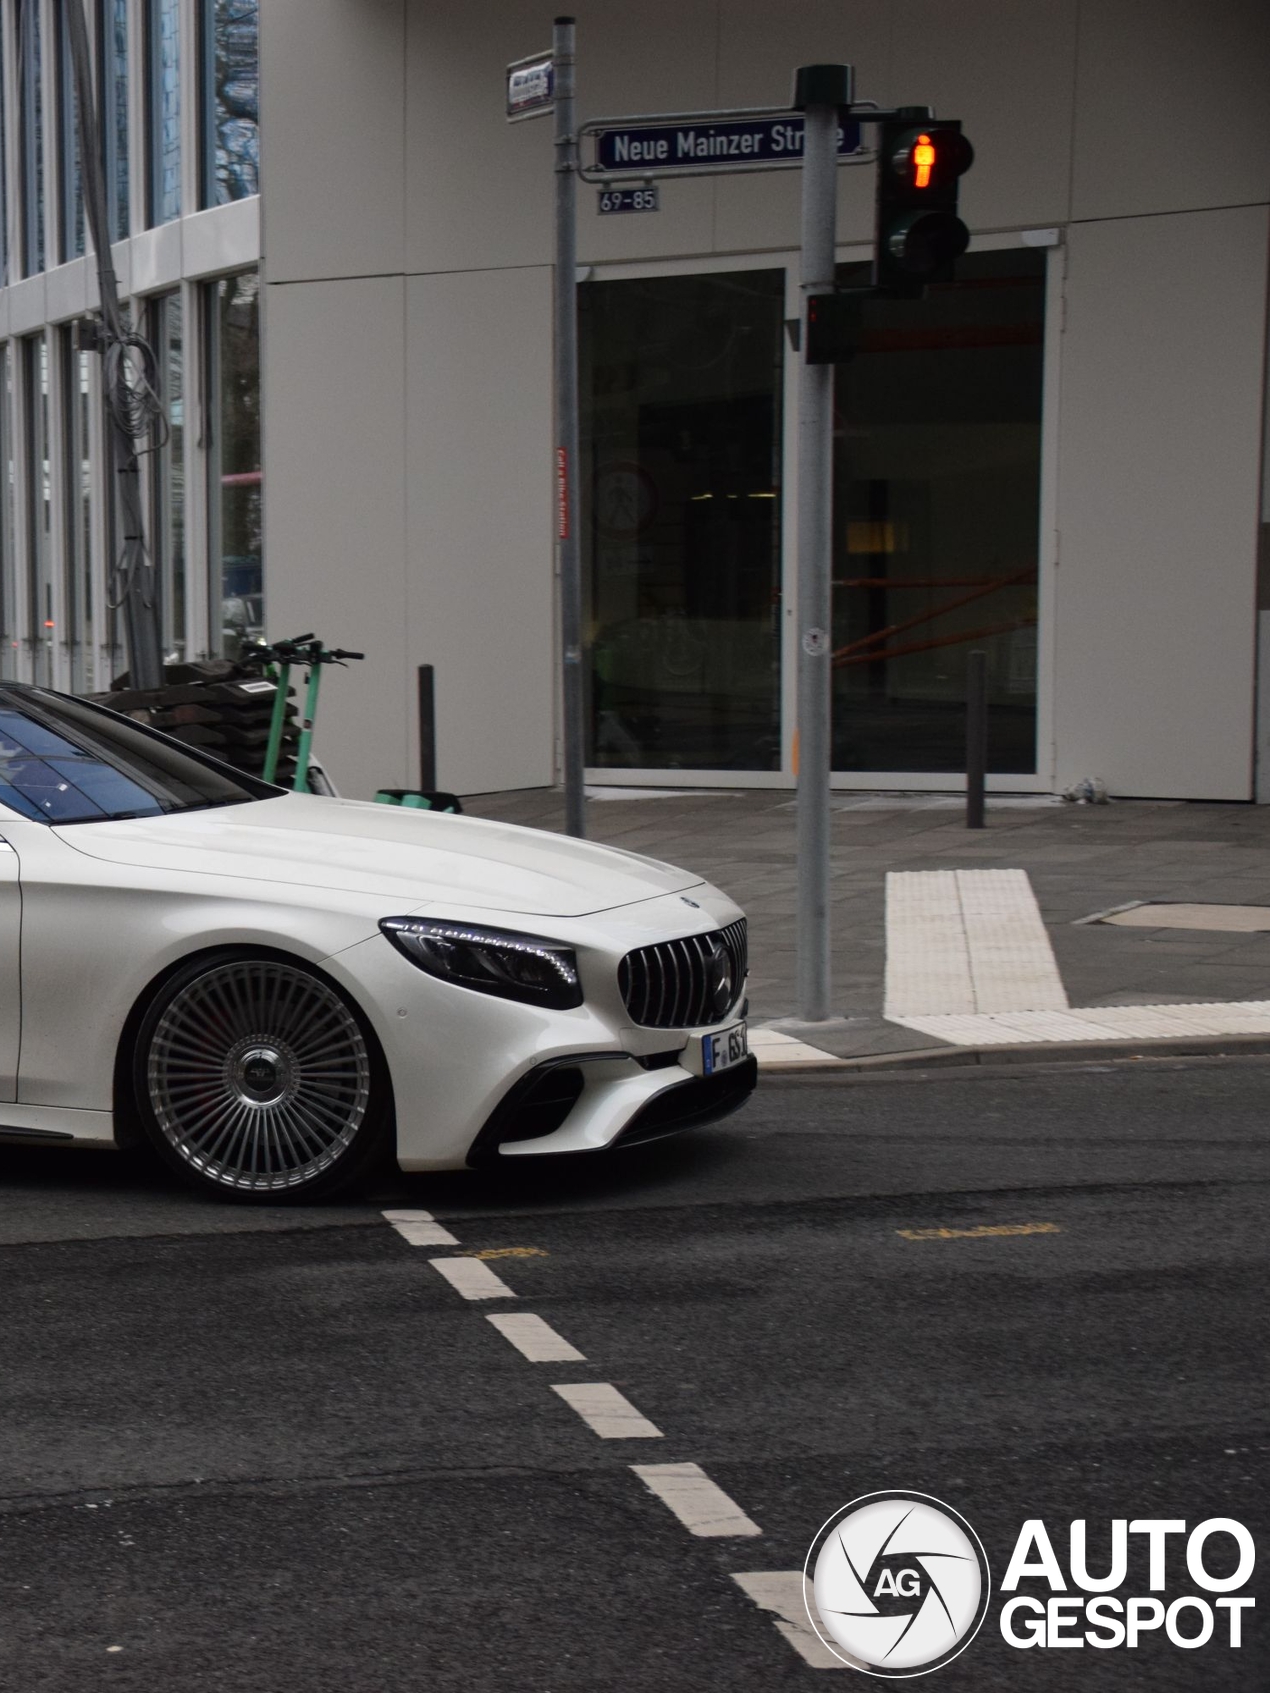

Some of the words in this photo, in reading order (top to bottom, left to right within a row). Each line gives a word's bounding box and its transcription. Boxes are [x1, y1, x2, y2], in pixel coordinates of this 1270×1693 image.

[614, 135, 669, 162] Neue
[677, 129, 764, 158] Mainzer
[771, 124, 845, 151] Stre
[601, 191, 655, 210] 69-85
[712, 1037, 721, 1068] F
